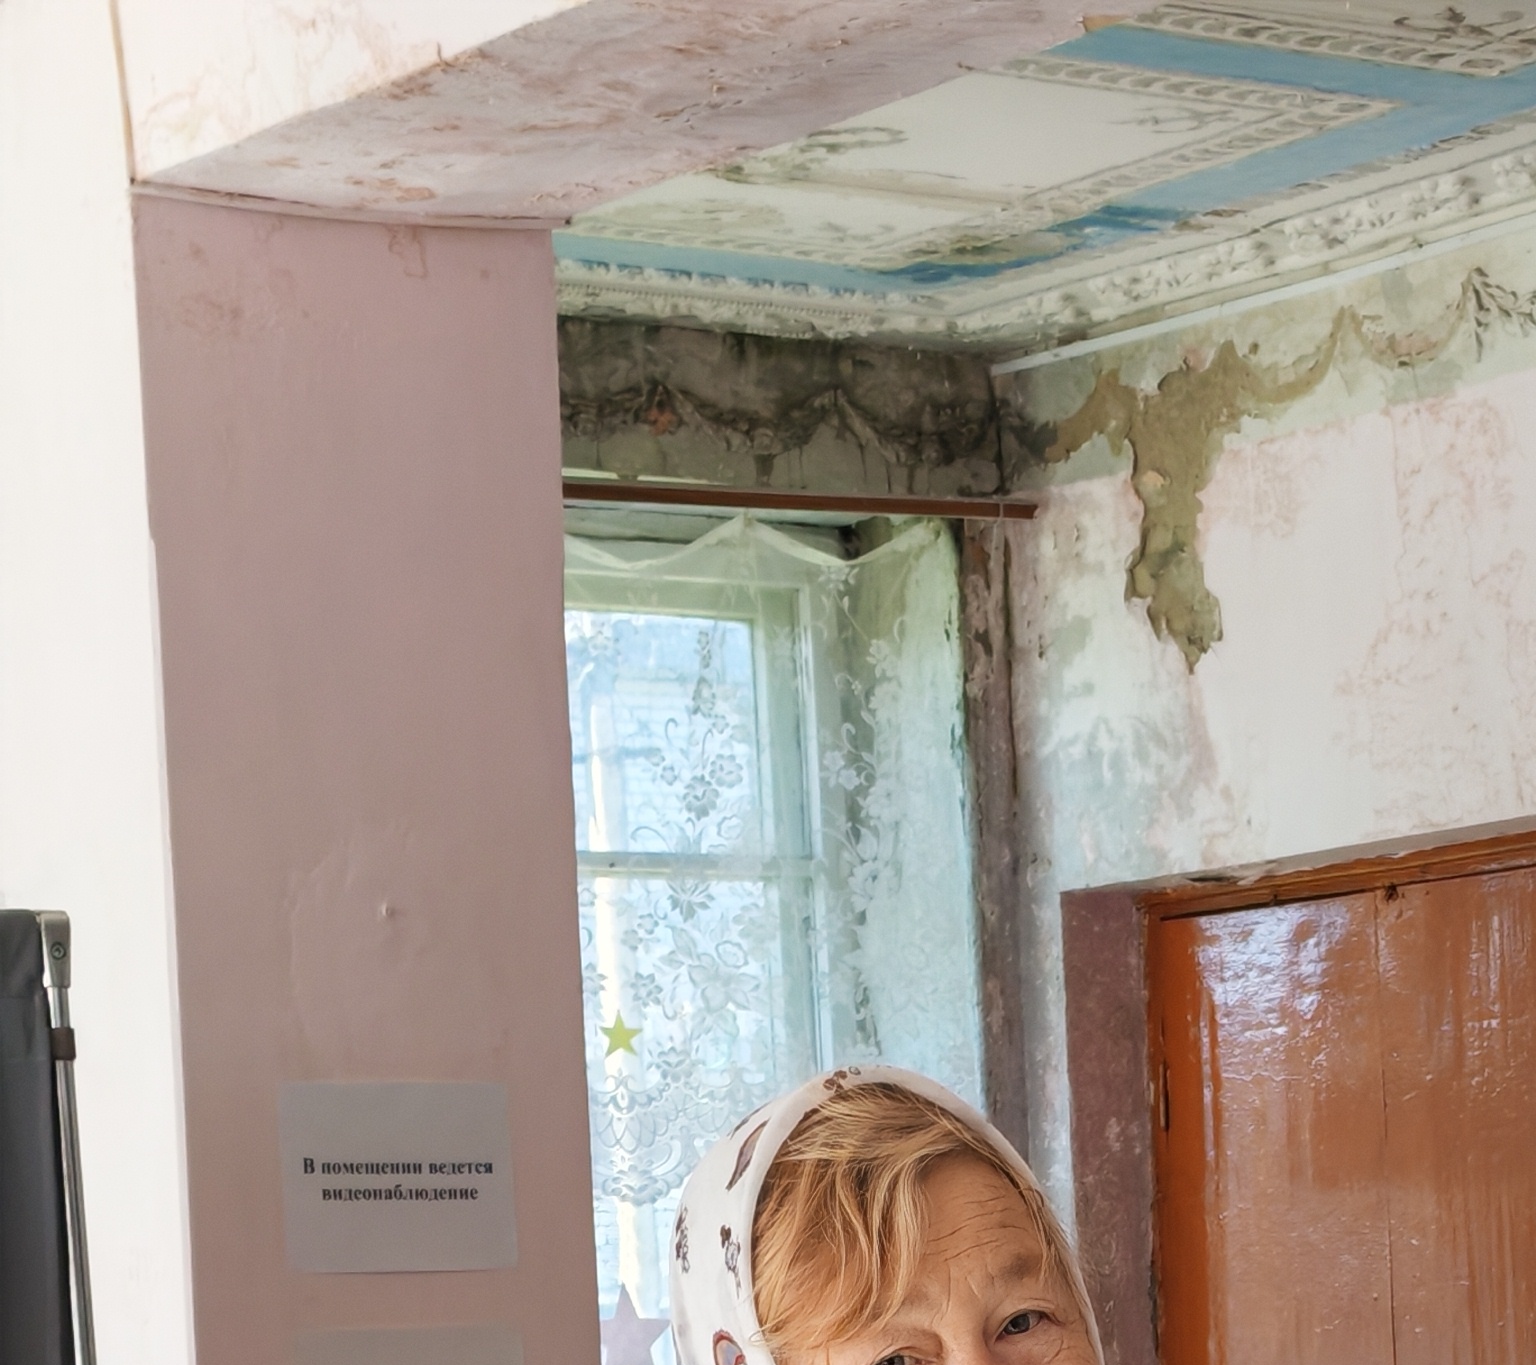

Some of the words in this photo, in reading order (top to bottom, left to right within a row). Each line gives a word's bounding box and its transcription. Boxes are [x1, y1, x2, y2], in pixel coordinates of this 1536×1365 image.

[303, 1157, 316, 1174] В
[321, 1160, 423, 1177] помещении
[429, 1161, 494, 1176] ведется
[322, 1184, 479, 1202] видеонаблюдение
